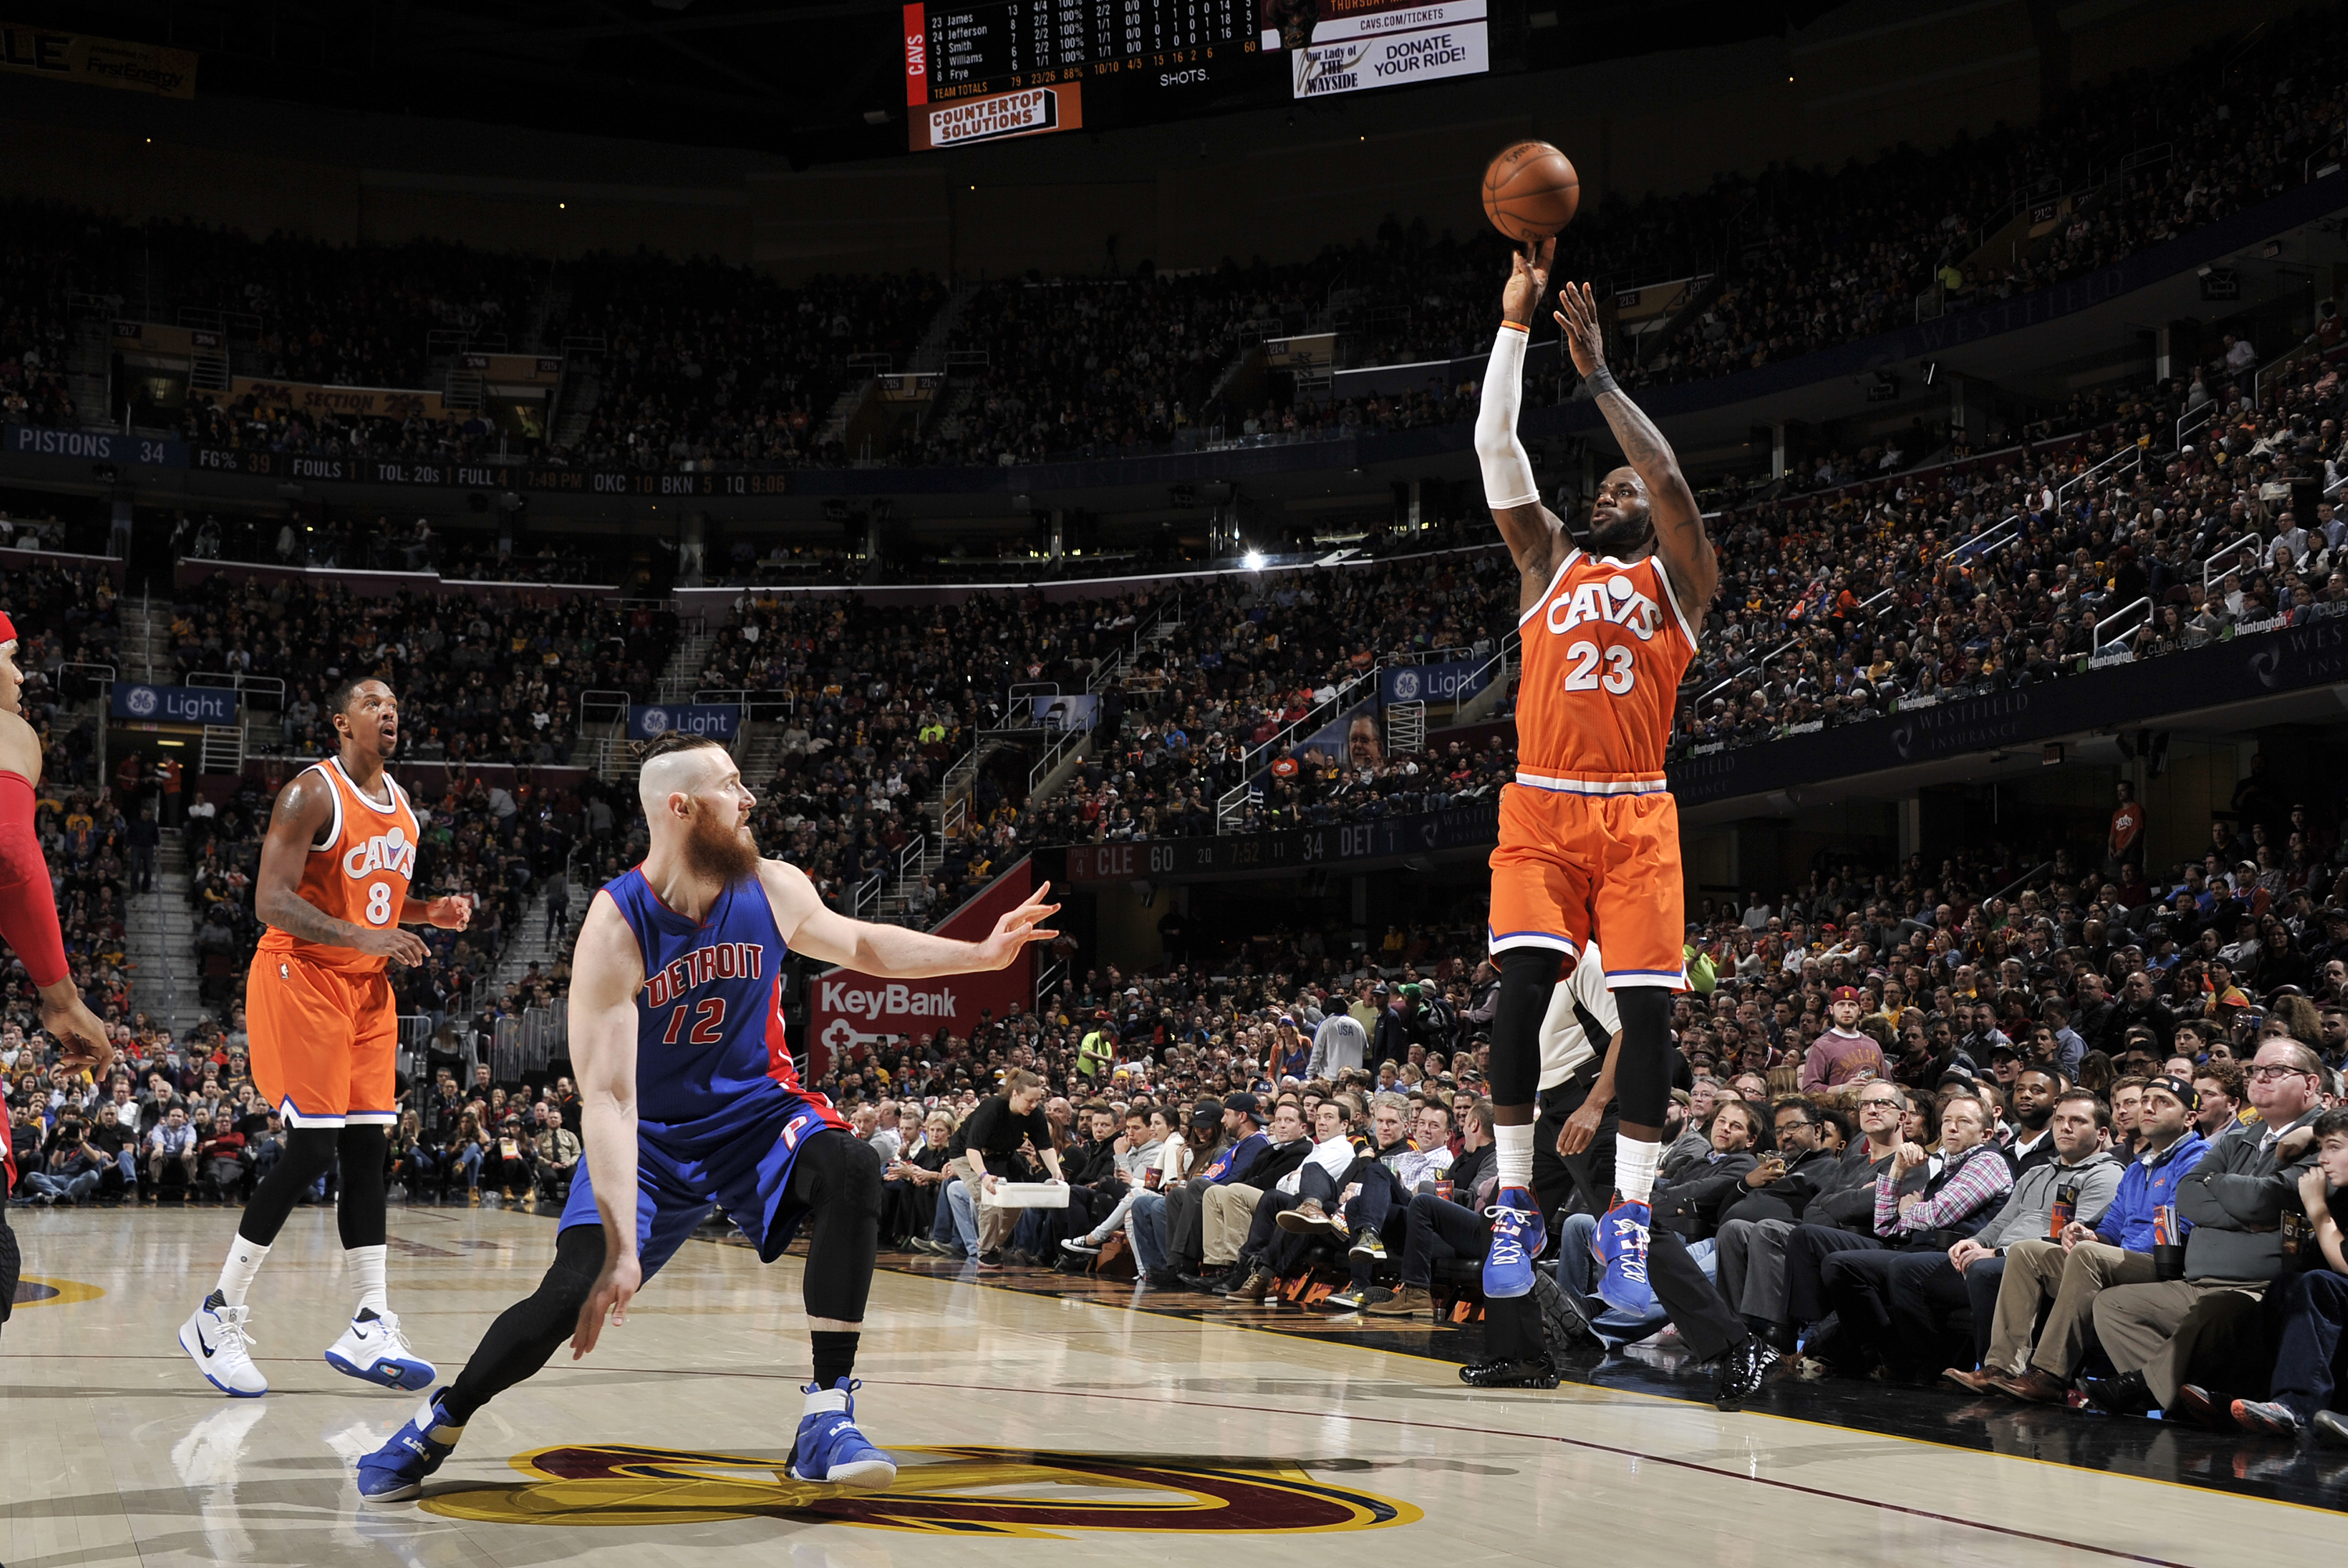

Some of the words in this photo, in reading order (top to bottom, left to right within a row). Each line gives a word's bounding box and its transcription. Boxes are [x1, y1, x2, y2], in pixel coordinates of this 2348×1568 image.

[932, 18, 942, 28] 23
[947, 13, 973, 26] James
[1008, 5, 1017, 16] 13
[1033, 0, 1047, 12] 4/4
[932, 31, 942, 42] 24
[948, 25, 987, 40] Jefferson
[1010, 20, 1015, 30] 8
[1034, 14, 1048, 26] 2/2
[1059, 8, 1082, 23] 100%
[1096, 4, 1111, 16] 2/2
[1125, 0, 1140, 12] 0/0
[1360, 9, 1444, 31] CAVS.COM/TICKETS
[949, 41, 972, 53] Smith
[1034, 28, 1049, 40] 2/2
[1059, 22, 1083, 36] 100%
[1097, 18, 1110, 31] 1/1
[1125, 13, 1140, 26] 0/0
[1220, 0, 1230, 11] 14
[949, 53, 983, 67] Williams
[1035, 41, 1049, 54] 2/2
[1060, 36, 1084, 50] 100%
[1097, 32, 1111, 44] 1/1
[1125, 27, 1140, 40] 0/0
[1190, 19, 1195, 30] 0
[1220, 13, 1231, 25] 18
[1246, 10, 1251, 21] 5
[0, 27, 70, 72] LE
[907, 34, 924, 75] CAVS
[950, 69, 969, 81] Frye
[1012, 59, 1017, 70] 6
[1036, 55, 1049, 67] 1/1
[1061, 50, 1085, 63] 100%
[1098, 45, 1111, 57] 1/1
[1126, 41, 1141, 53] 0/0
[1155, 38, 1161, 49] 3
[1174, 35, 1179, 46] 0
[1190, 32, 1196, 44] 0
[1221, 27, 1231, 38] 16
[1247, 24, 1252, 35] 3
[1306, 50, 1322, 62] Our
[1324, 47, 1345, 60] Lady
[1348, 45, 1356, 56] of
[1386, 34, 1452, 59] DONATE
[86, 56, 184, 88] FirstEnergy
[935, 86, 956, 99] TEAM
[958, 81, 988, 95] TOTALS
[1011, 76, 1021, 88] 79
[1032, 70, 1056, 85] 23/26
[1064, 67, 1083, 80] 88%
[1094, 61, 1119, 75] 10/10
[1128, 58, 1142, 70] 4/5
[1154, 55, 1164, 67] 15
[1173, 52, 1183, 63] 16
[1190, 49, 1196, 61] 2
[1207, 47, 1212, 58] 6
[1244, 41, 1255, 52] 60
[1320, 59, 1343, 75] THE
[1374, 56, 1420, 77] YOUR
[1423, 47, 1466, 68] RIDE!
[1160, 69, 1210, 86] SHOTS.
[1308, 73, 1358, 94] WAYSIDE
[933, 91, 1043, 128] COUNTERTOP
[942, 109, 1033, 140] SOLUTIONS
[2035, 207, 2051, 221] 212
[1619, 294, 1635, 307] 213
[1921, 270, 2124, 350] WESTFIELD
[118, 325, 136, 336] 217
[1269, 344, 1284, 354] 214
[541, 361, 557, 371] 215
[884, 379, 899, 389] 215
[304, 391, 374, 409] SECTION
[19, 429, 110, 458] PISTONS
[140, 441, 164, 463] 34
[200, 450, 236, 469] FG%
[248, 452, 271, 473] 39
[294, 459, 341, 478] FOULS
[349, 461, 356, 480] 1
[1043, 456, 1230, 485] WESTFIELD
[378, 464, 409, 481] TOL:
[446, 466, 452, 484] 1
[459, 469, 494, 485] FULL
[498, 469, 507, 487] 4
[527, 471, 556, 487] 7:49
[561, 473, 582, 488] PM
[595, 473, 625, 492] OKC
[636, 475, 654, 493] 10
[662, 476, 693, 494] BKN
[704, 476, 712, 494] 5
[726, 476, 744, 494] 1Q
[752, 475, 785, 493] 9:06
[1547, 579, 1663, 641] CAVS
[2235, 616, 2287, 636] Huntington
[2148, 641, 2173, 655] CLUB
[2176, 634, 2203, 649] LEVEL
[1565, 640, 1635, 696] 23
[2088, 651, 2134, 670] Huntington
[1428, 668, 1478, 698] Light
[167, 694, 224, 721] Light
[1898, 695, 1936, 711] Huntington
[1920, 693, 2029, 730] WESTFIELD
[677, 712, 727, 736] Light
[1790, 719, 1824, 735] Huntington
[1932, 722, 2018, 750] INSURANCE
[1694, 742, 1724, 755] Huntington
[1668, 755, 1735, 783] ESTFIELD
[1676, 779, 1728, 799] SURANCE
[1443, 806, 1497, 826] WESTFI
[1388, 832, 1393, 851] 1
[1451, 828, 1496, 842] INSURAN
[343, 833, 416, 881] CAVS
[1097, 846, 1133, 875] CLE
[1151, 845, 1173, 872] 60
[1197, 848, 1212, 864] 2Q
[1231, 842, 1259, 864] 7:52
[1273, 843, 1284, 858] 11
[1303, 832, 1323, 861] 34
[1341, 824, 1374, 858] DET
[1076, 860, 1083, 876] 4
[366, 882, 391, 925] 8
[644, 942, 763, 1009] DETROIT
[822, 981, 956, 1020] KeyBank
[662, 997, 726, 1045] 12
[1338, 1024, 1353, 1036] USA
